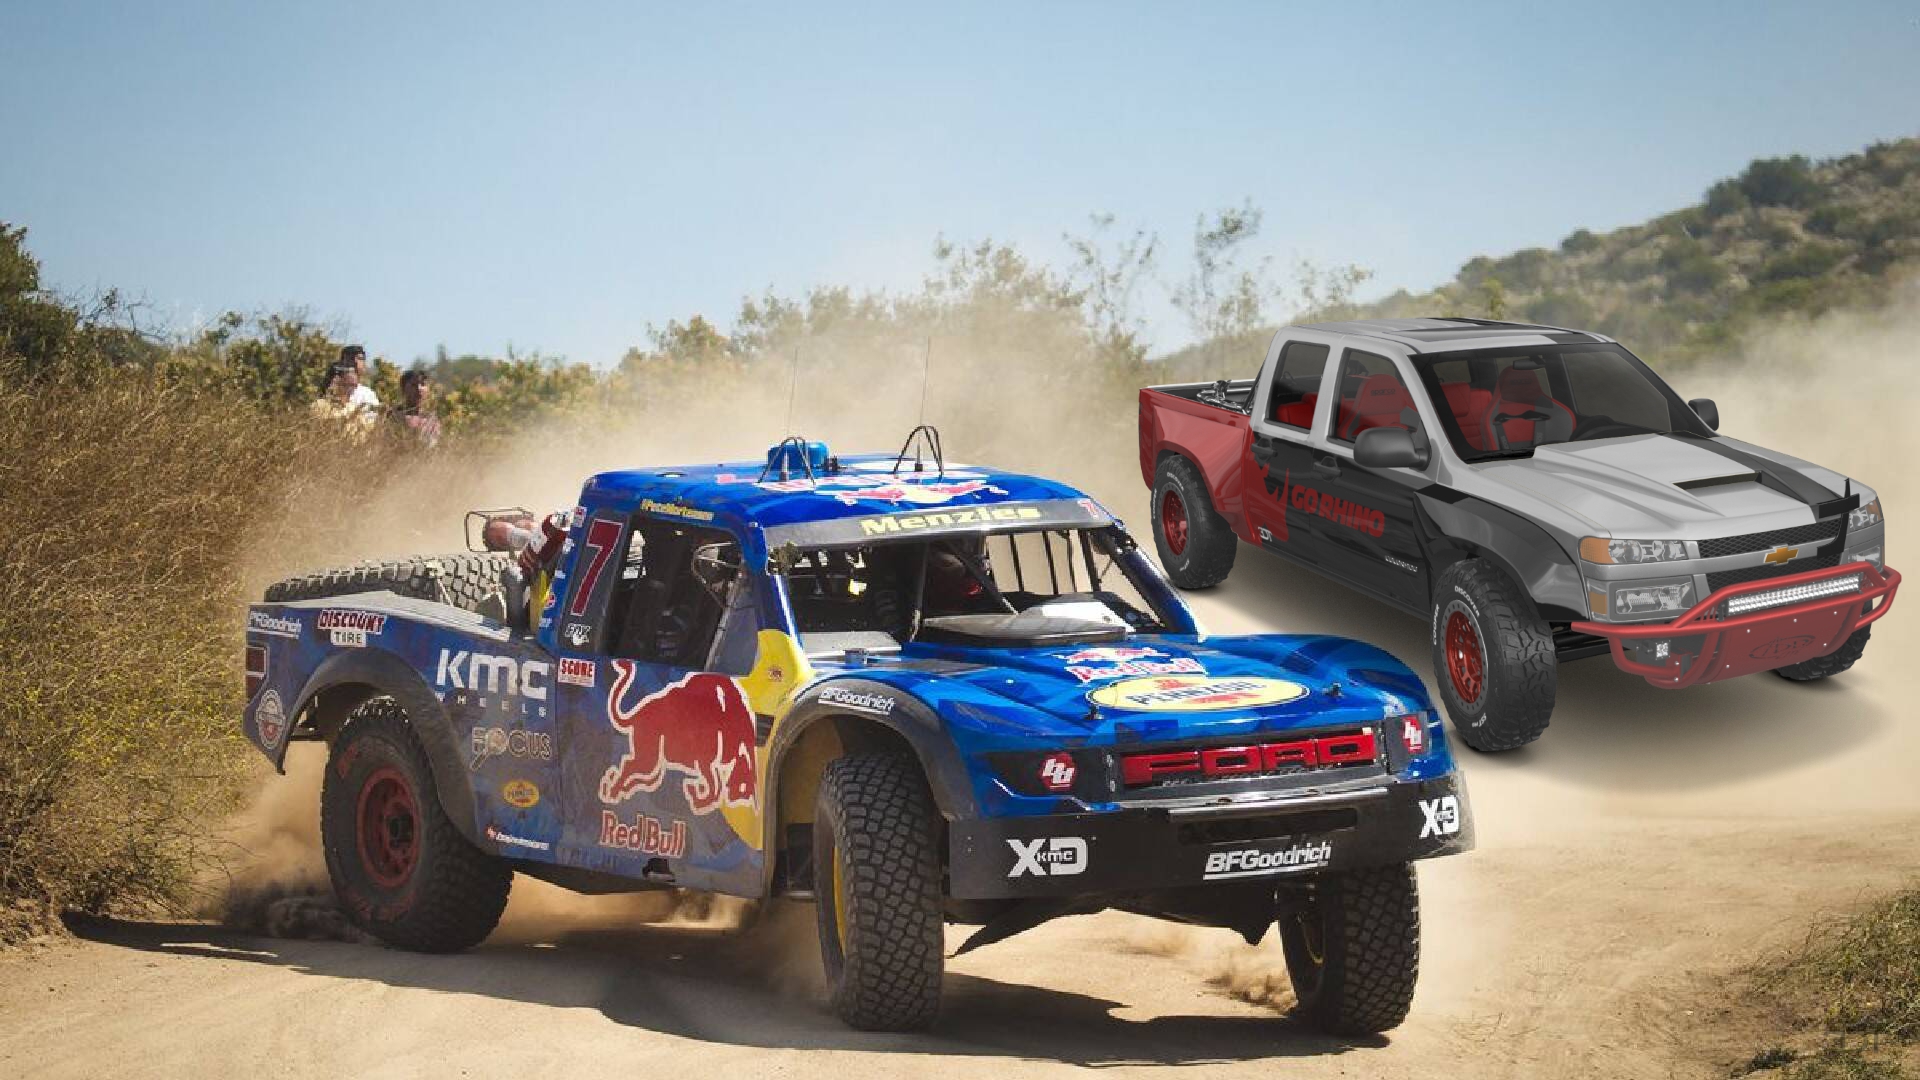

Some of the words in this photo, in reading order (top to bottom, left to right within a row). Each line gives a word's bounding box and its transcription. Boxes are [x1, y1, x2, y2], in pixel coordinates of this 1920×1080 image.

[860, 507, 1041, 536] Menzies
[1291, 484, 1319, 514] GO
[1318, 492, 1385, 538] RHINO
[566, 519, 623, 616] 7
[318, 609, 388, 634] DISCOUNT
[334, 631, 363, 644] TIRE
[1432, 603, 1440, 646] COOPER
[1122, 733, 1375, 785] FORD
[601, 810, 644, 851] Red
[643, 817, 686, 858] Bull
[1006, 836, 1088, 878] XD
[1205, 841, 1332, 873] BFGoodrich
